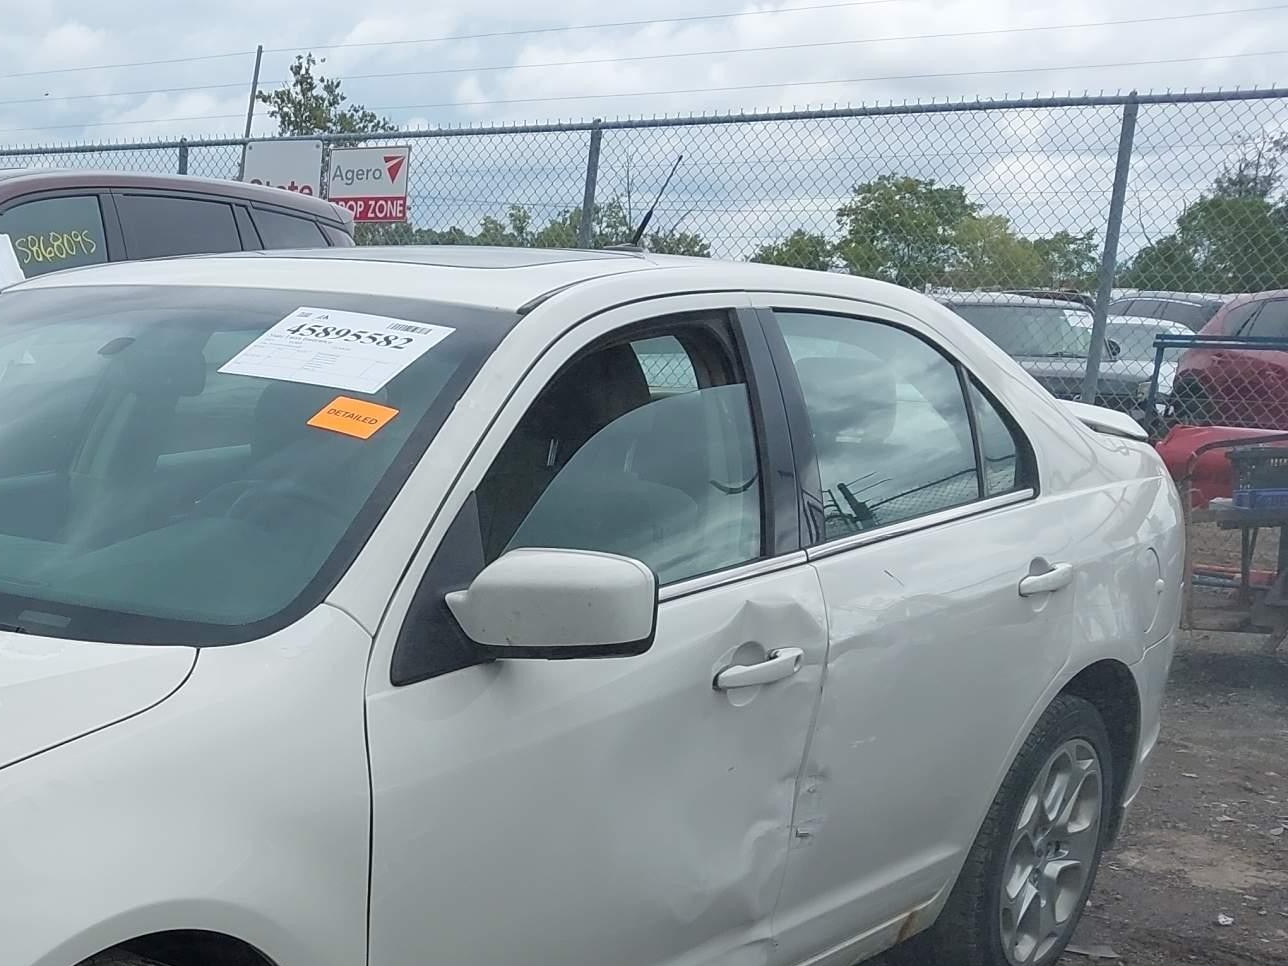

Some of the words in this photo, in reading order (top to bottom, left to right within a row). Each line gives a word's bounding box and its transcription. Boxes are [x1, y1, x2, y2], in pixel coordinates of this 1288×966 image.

[332, 165, 382, 185] Agero
[367, 199, 404, 218] ZONE
[286, 322, 414, 350] 45895582
[326, 407, 379, 426] DETAILED
